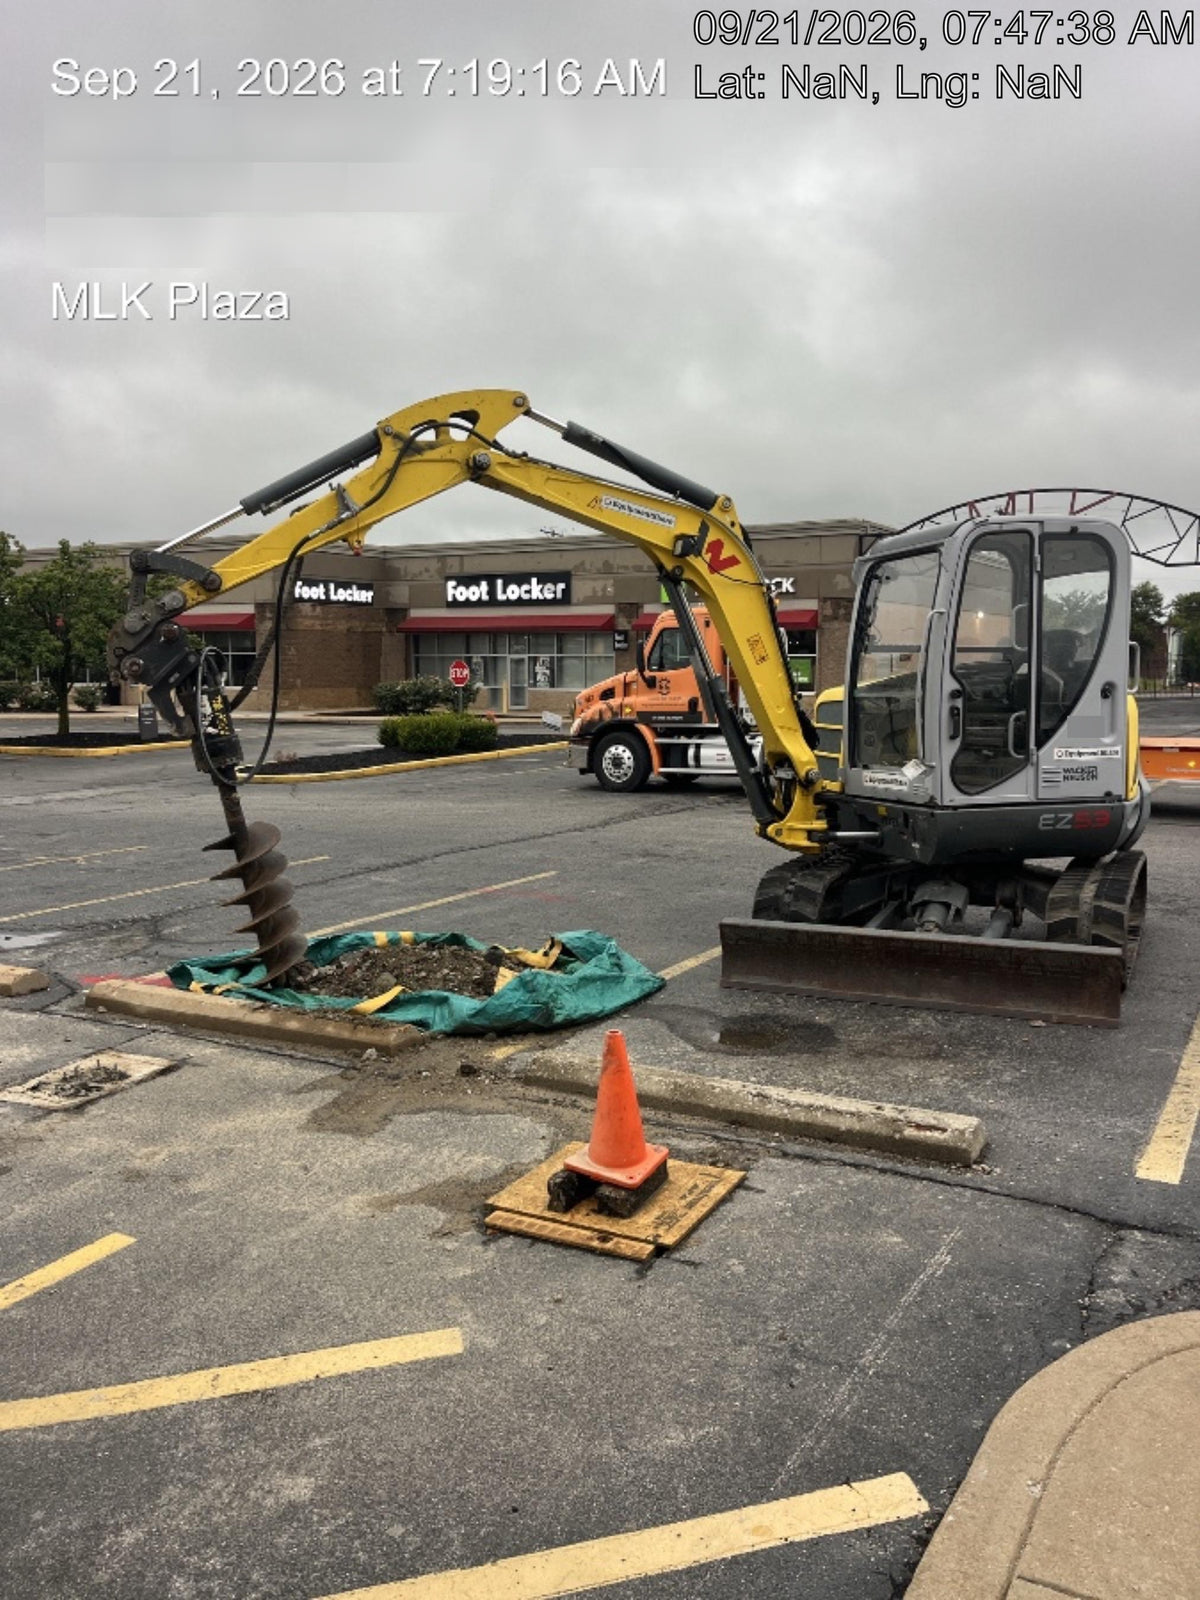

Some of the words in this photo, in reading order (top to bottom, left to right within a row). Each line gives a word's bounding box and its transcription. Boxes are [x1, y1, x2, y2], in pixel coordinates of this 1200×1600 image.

[294, 581, 326, 600] Foot
[328, 582, 374, 603] Locker
[446, 580, 490, 602] Foot
[496, 577, 566, 601] Locker
[1038, 809, 1111, 830] EZ53
